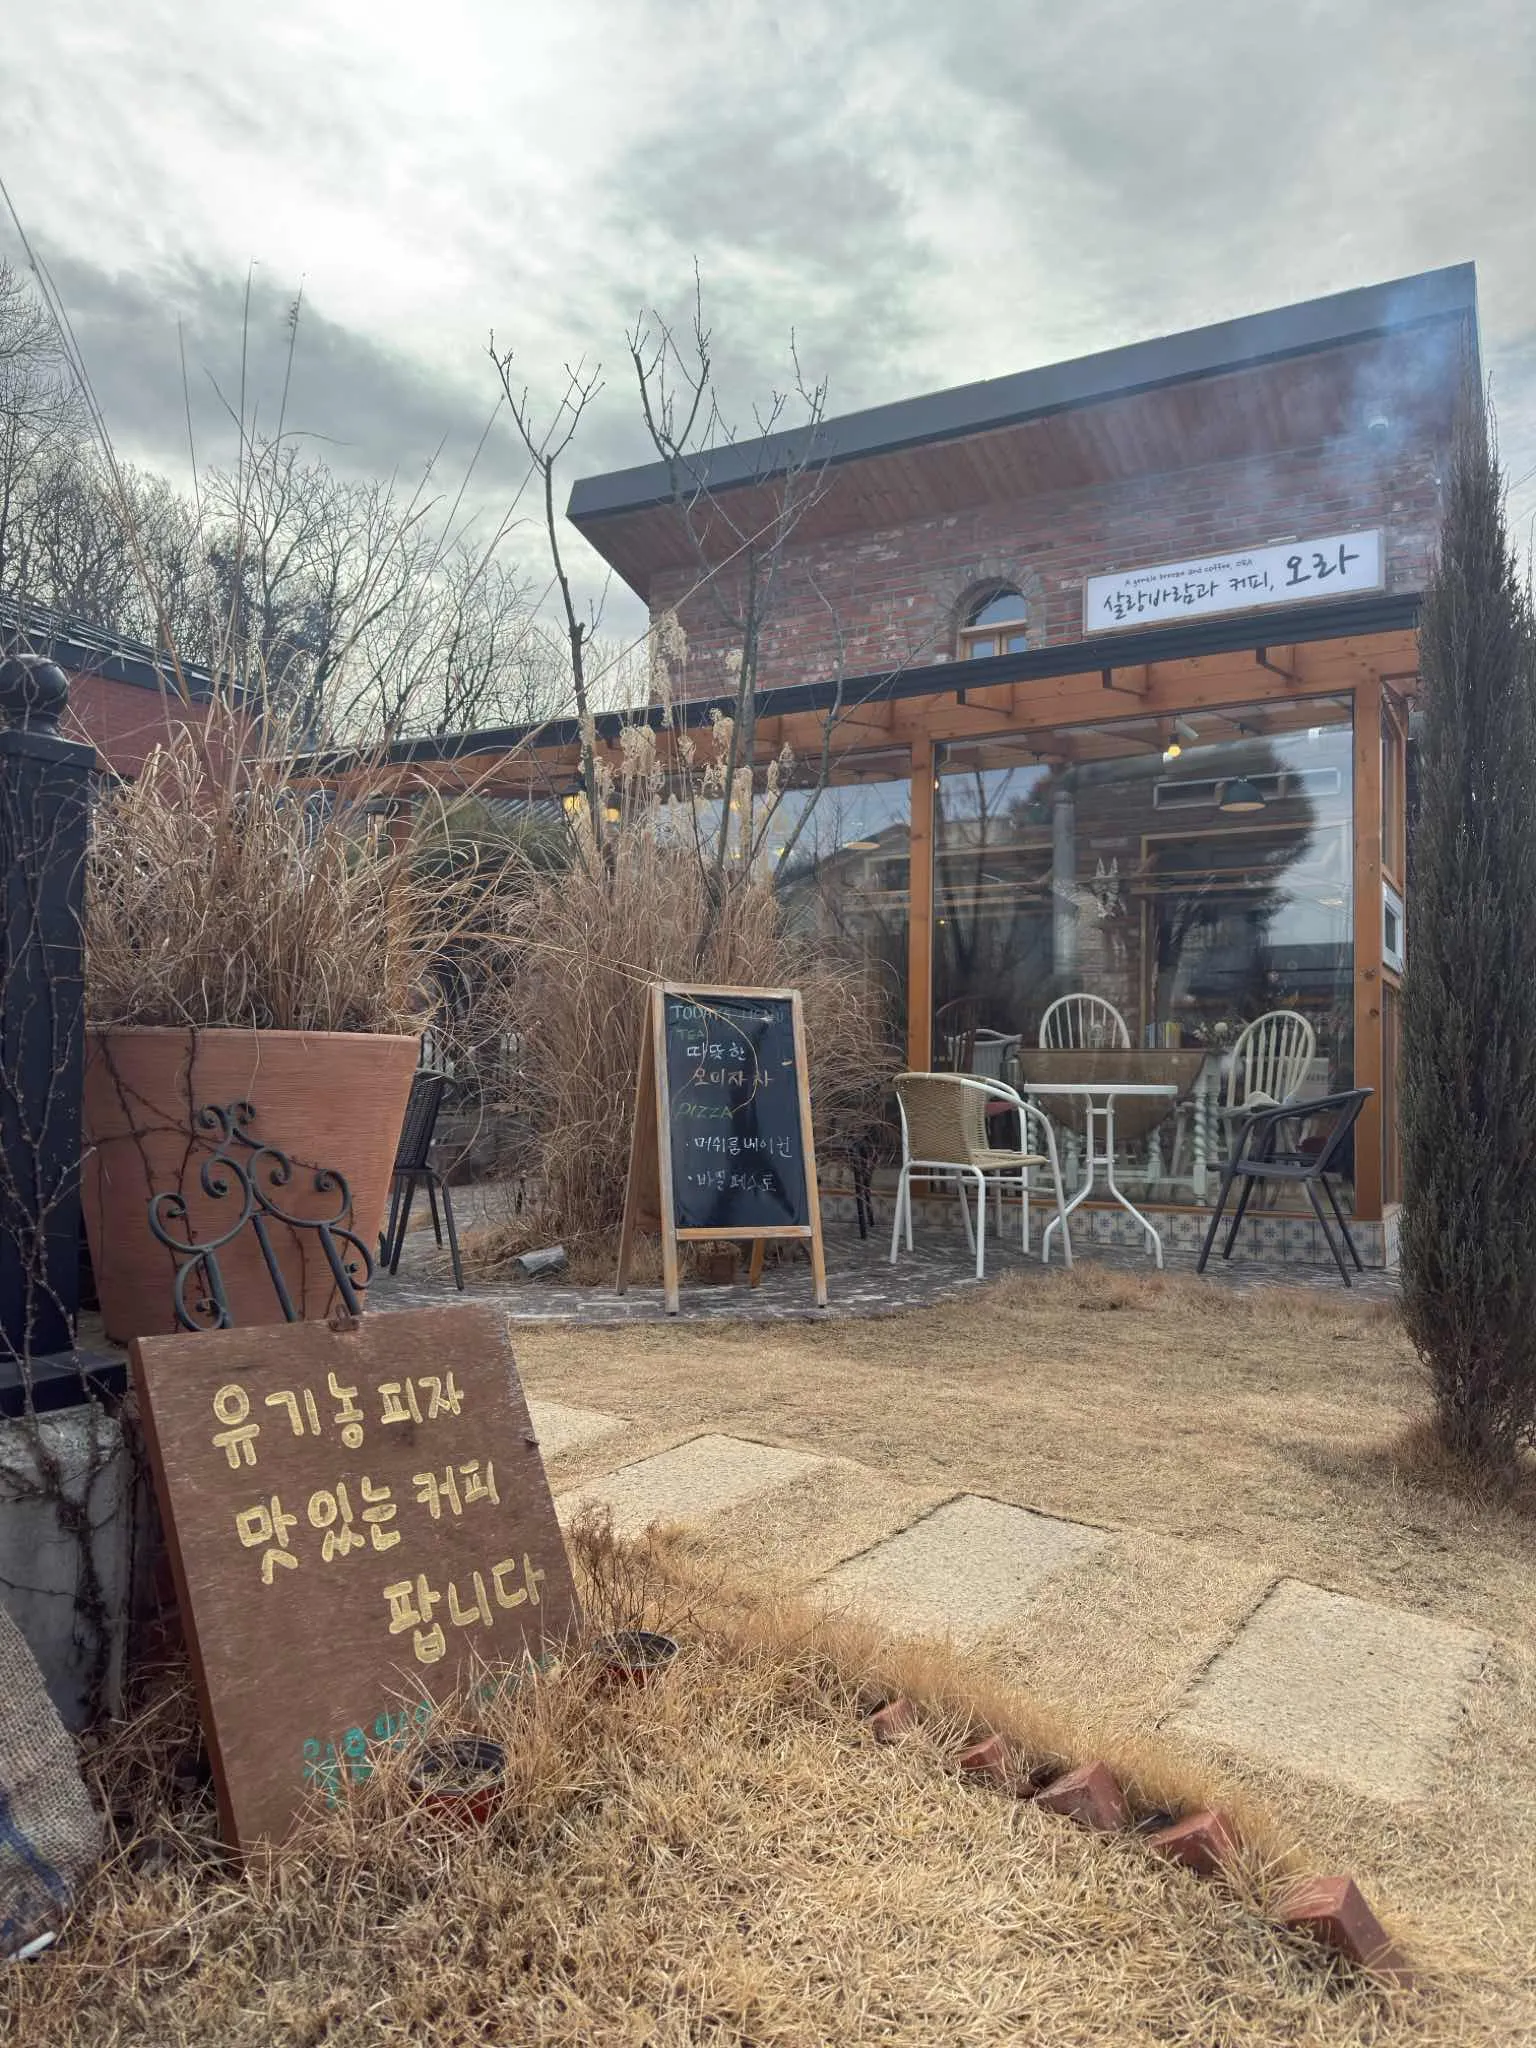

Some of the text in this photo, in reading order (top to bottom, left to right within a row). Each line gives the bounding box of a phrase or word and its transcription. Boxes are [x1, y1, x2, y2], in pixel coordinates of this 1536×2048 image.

[1103, 543, 1361, 620] 살랑바람과 커피, 오라
[212, 1370, 465, 1469] 유기농 피자
[235, 1459, 501, 1585] 맛있는 커피
[383, 1552, 546, 1664] 팝니다
